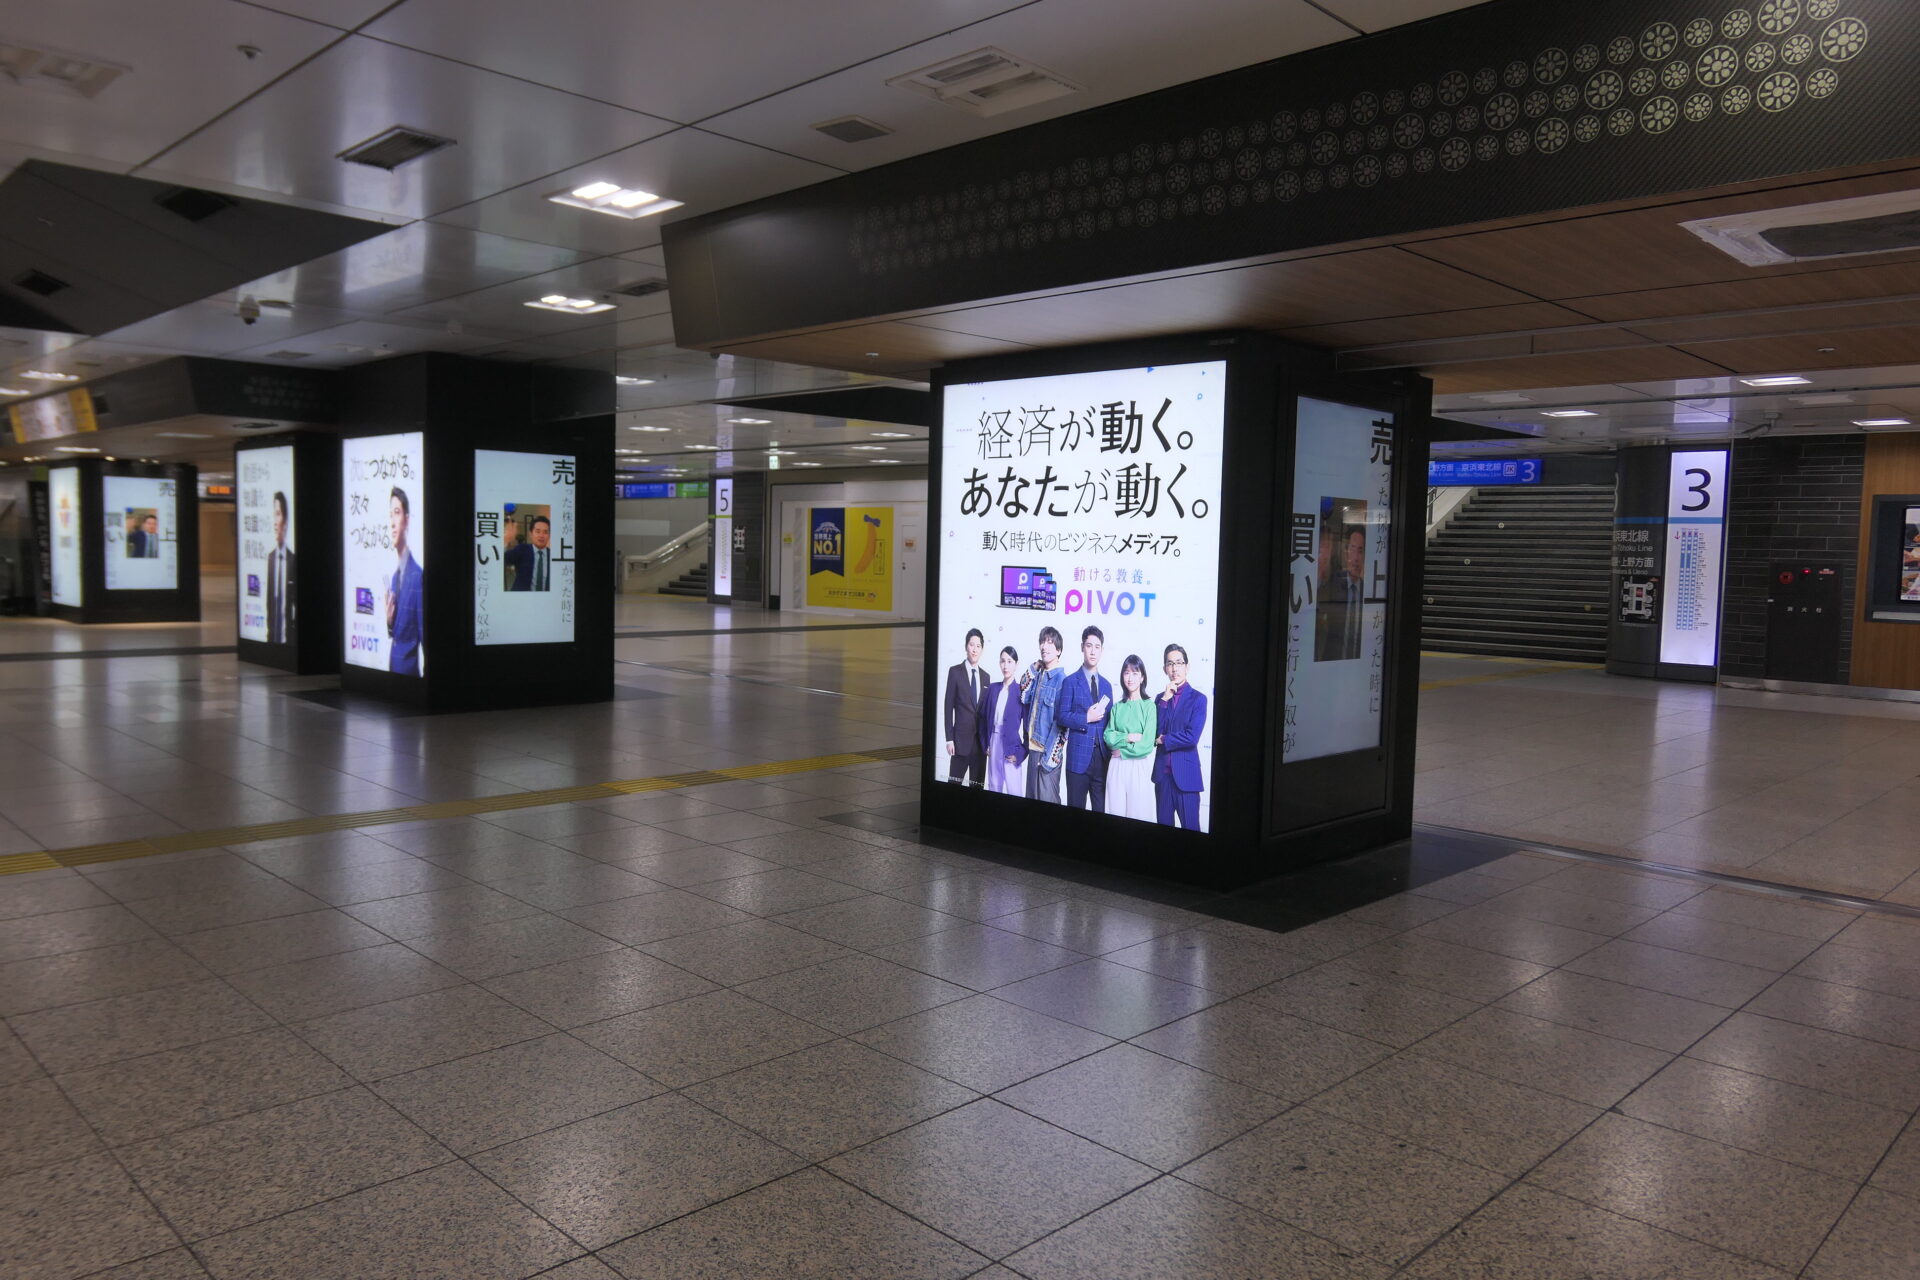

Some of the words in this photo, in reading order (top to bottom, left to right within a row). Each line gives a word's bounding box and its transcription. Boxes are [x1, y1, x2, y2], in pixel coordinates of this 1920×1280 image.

[978, 397, 1194, 460] 経済が動く。
[960, 462, 1208, 519] あなたが動く。
[1521, 461, 1535, 482] 3
[1682, 468, 1711, 511] 3
[350, 491, 370, 516] 次々
[720, 488, 728, 512] 5
[552, 459, 576, 623] 売った株が上がった時に
[982, 530, 1181, 558] 動く時代のビジネスメディア。
[1637, 544, 1653, 552] Line
[475, 512, 500, 641] 買いに行く奴が
[1073, 566, 1151, 585] 動ける教養。
[1363, 418, 1393, 713] 売った株が上がった時に
[1283, 512, 1316, 754] 買いに行く奴が
